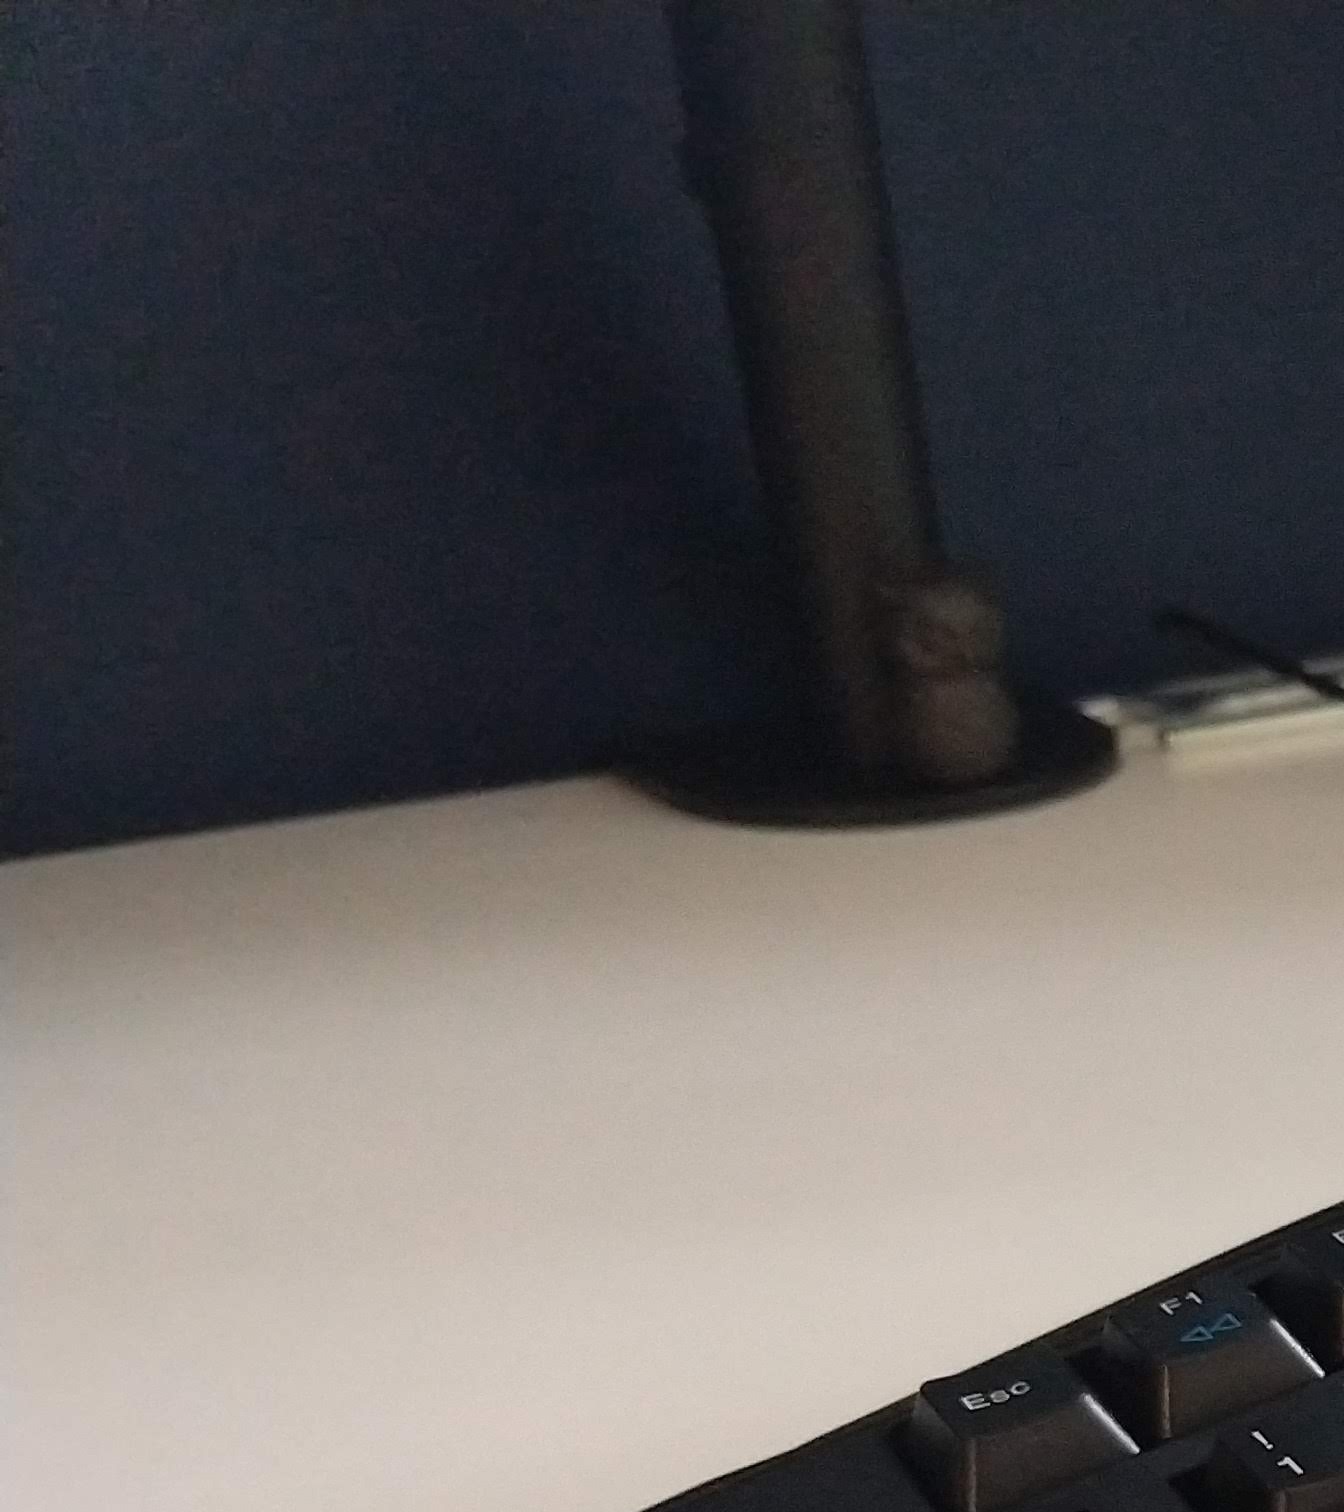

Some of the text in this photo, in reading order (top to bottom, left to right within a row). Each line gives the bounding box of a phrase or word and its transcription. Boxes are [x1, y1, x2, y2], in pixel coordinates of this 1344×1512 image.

[1159, 1290, 1204, 1317] F1
[958, 1379, 1031, 1412] Esc
[1276, 1454, 1305, 1477] 1
